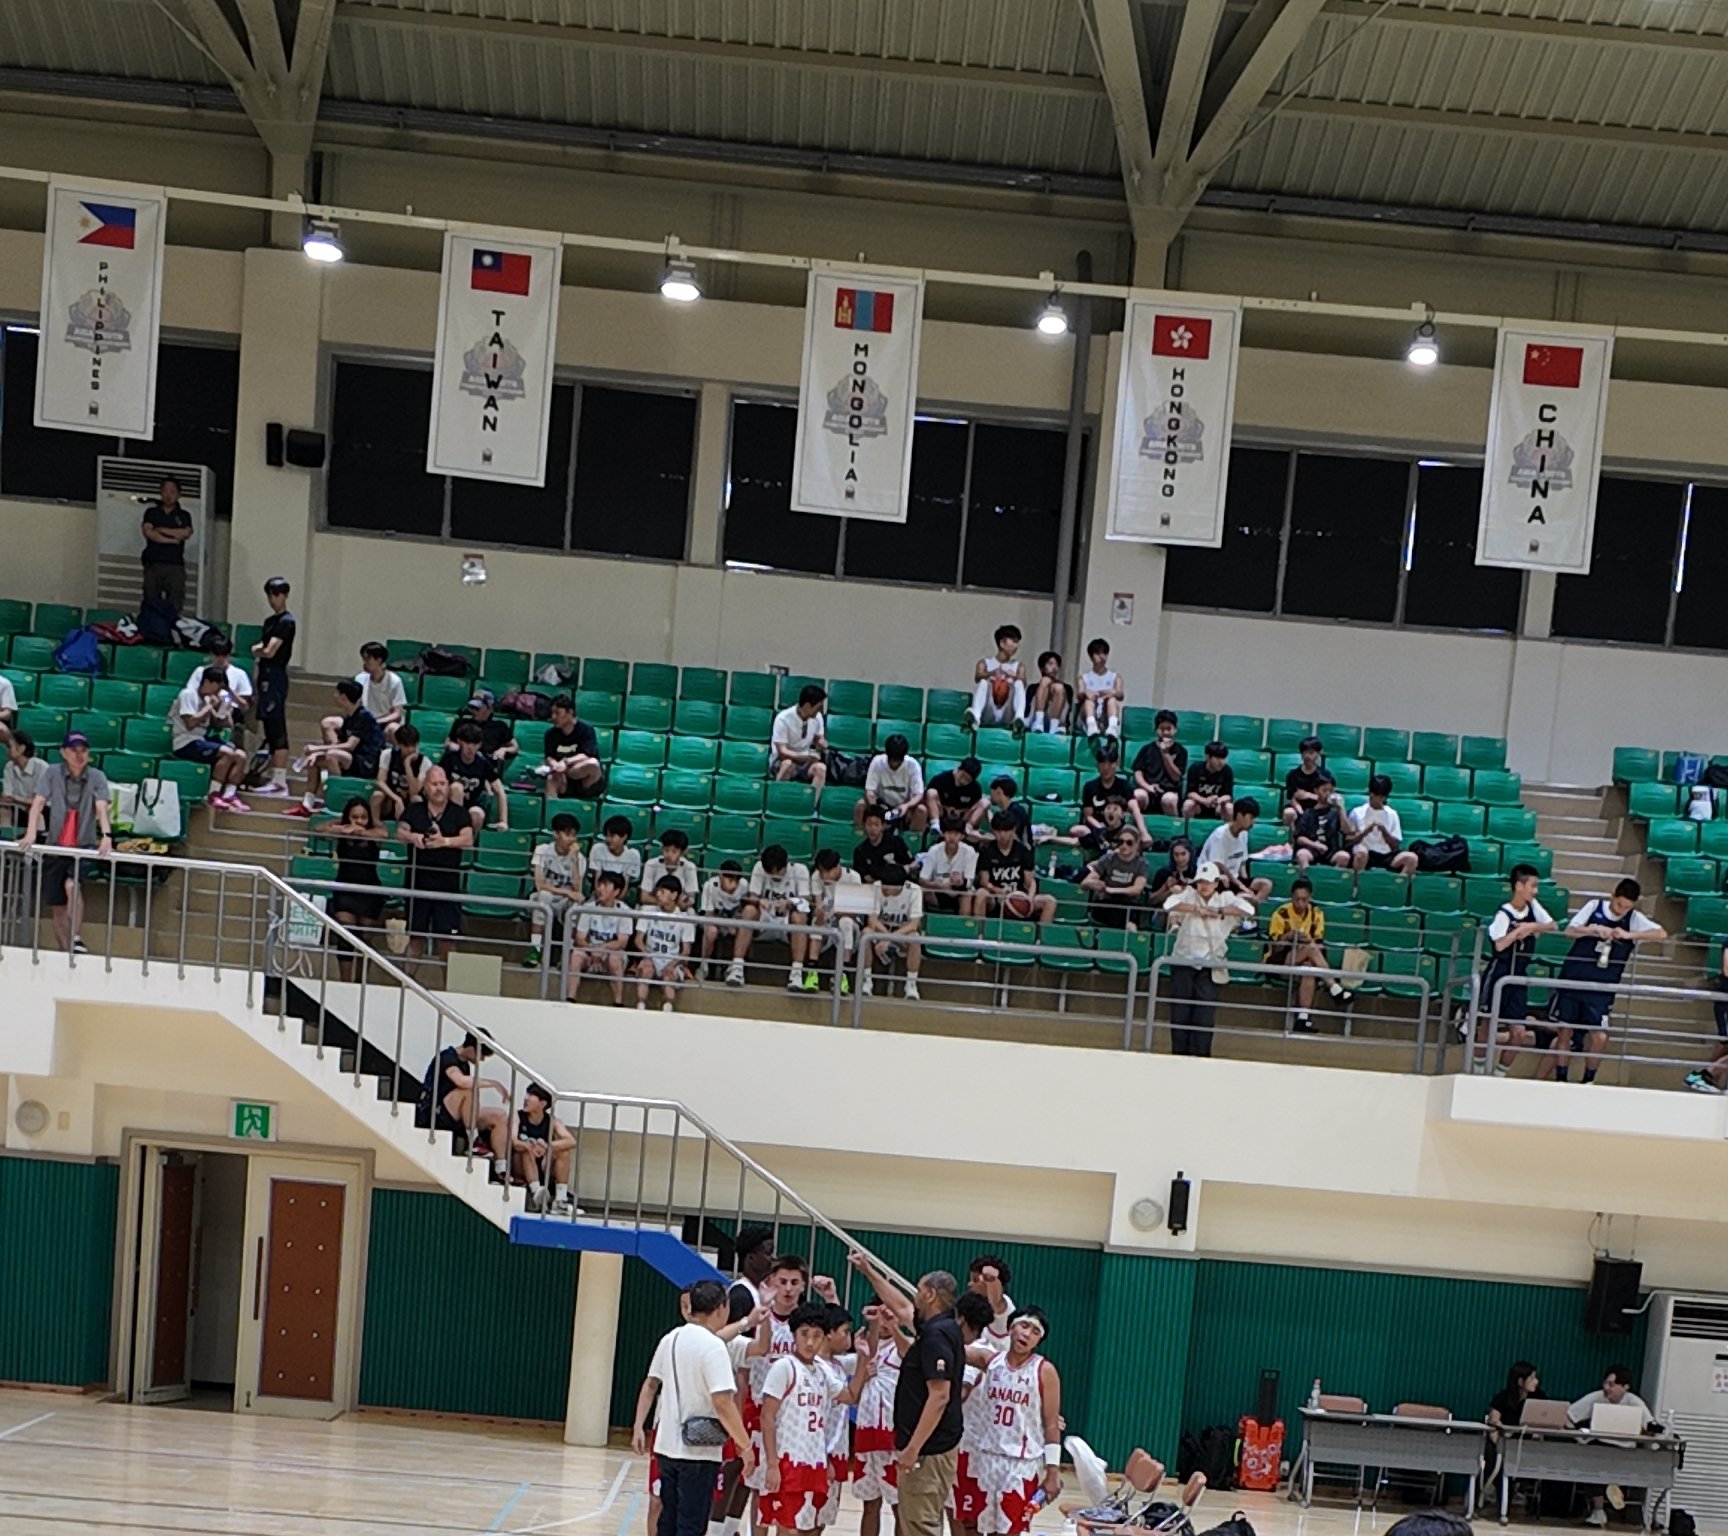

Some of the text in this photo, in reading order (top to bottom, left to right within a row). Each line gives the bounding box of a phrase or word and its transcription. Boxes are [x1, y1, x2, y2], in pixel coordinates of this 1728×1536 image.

[91, 261, 108, 391] PHILIPPINES
[482, 309, 506, 432] TAIWAN
[845, 343, 869, 482] MONGOLIA
[1162, 367, 1185, 497] HONGKONG
[1527, 403, 1557, 525] CHINA
[994, 1405, 1014, 1427] 30
